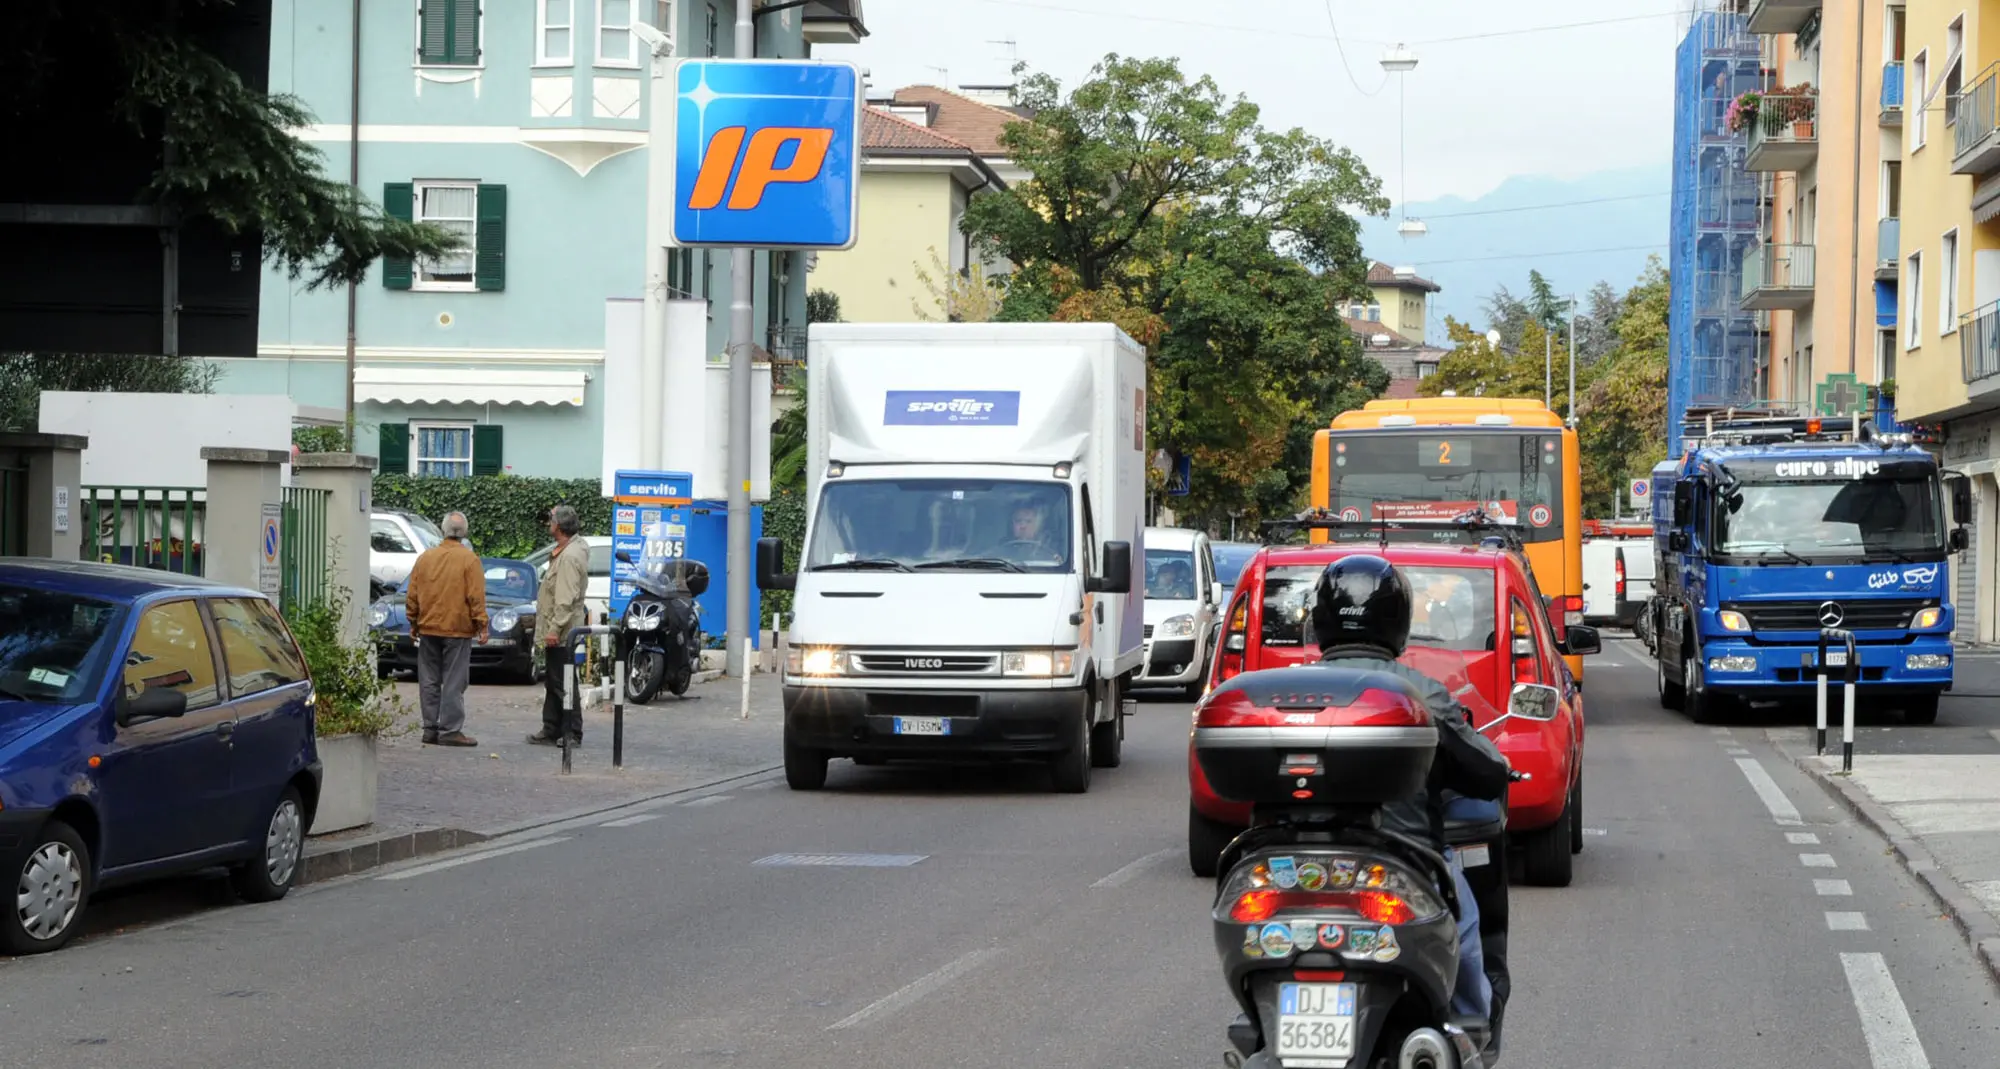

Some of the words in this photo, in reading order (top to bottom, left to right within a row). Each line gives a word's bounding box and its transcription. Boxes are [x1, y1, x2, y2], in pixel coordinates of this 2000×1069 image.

[688, 126, 834, 210] IP
[907, 398, 994, 416] SPORTLER
[1439, 440, 1451, 464] 2
[1775, 461, 1828, 477] euro
[1833, 456, 1880, 480] alpe
[629, 483, 677, 496] servito
[1344, 512, 1358, 522] 70
[1534, 511, 1546, 521] 80
[1433, 531, 1459, 539] MAN
[646, 540, 684, 558] 1.285
[1339, 605, 1366, 616] crivit
[905, 658, 943, 668] IVECO
[1299, 987, 1326, 1013] DJ
[1281, 1021, 1349, 1050] 36384
